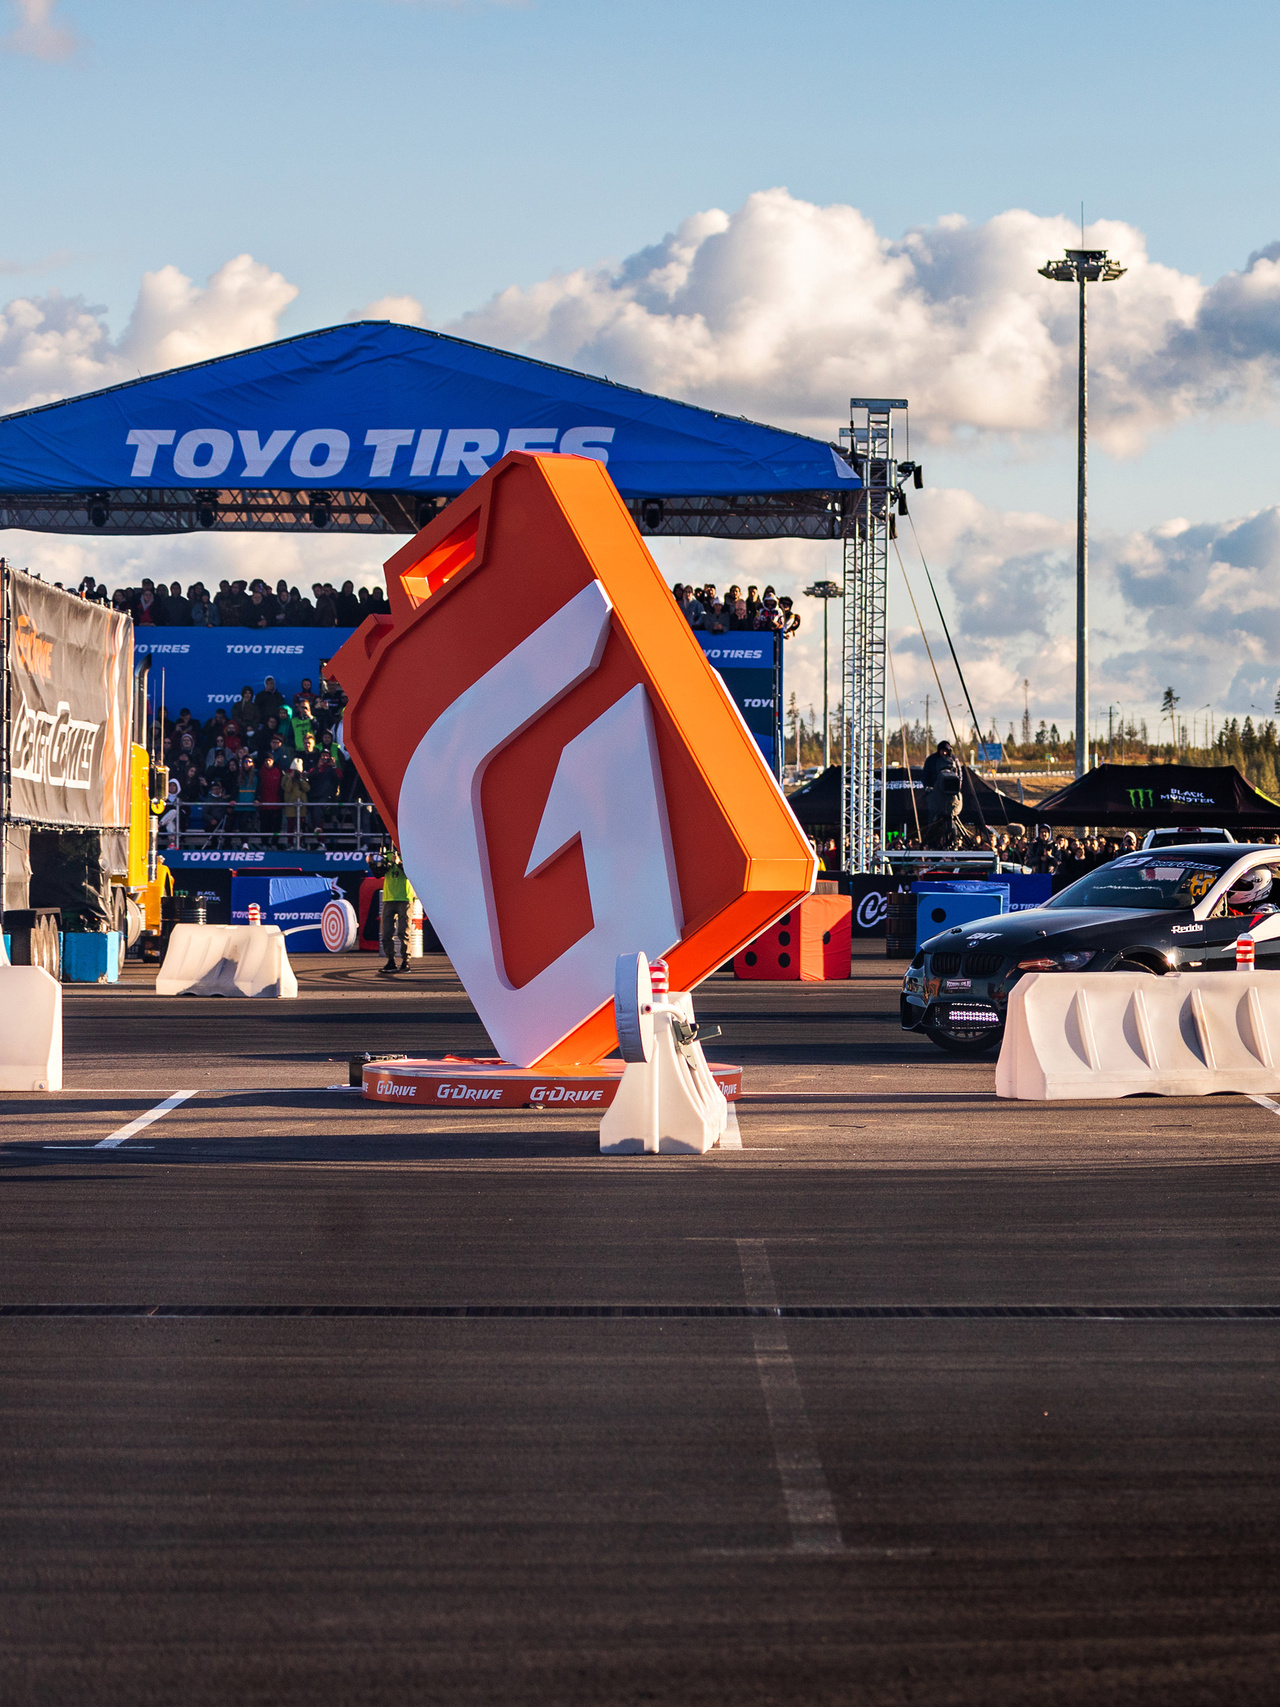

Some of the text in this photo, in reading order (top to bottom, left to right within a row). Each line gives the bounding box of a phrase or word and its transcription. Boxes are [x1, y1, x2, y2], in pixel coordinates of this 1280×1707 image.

[126, 428, 350, 478] TOYO
[150, 644, 190, 653] TIRES
[226, 644, 304, 654] TOYO TIRES
[722, 650, 763, 658] TIRES
[207, 694, 243, 703] TOYO
[1170, 788, 1204, 798] BLACK
[1160, 793, 1215, 804] MONSTER
[182, 852, 265, 861] TOYO TIRES
[324, 852, 363, 861] TOYO
[274, 912, 300, 920] TOYO
[1171, 923, 1204, 934] Reddy
